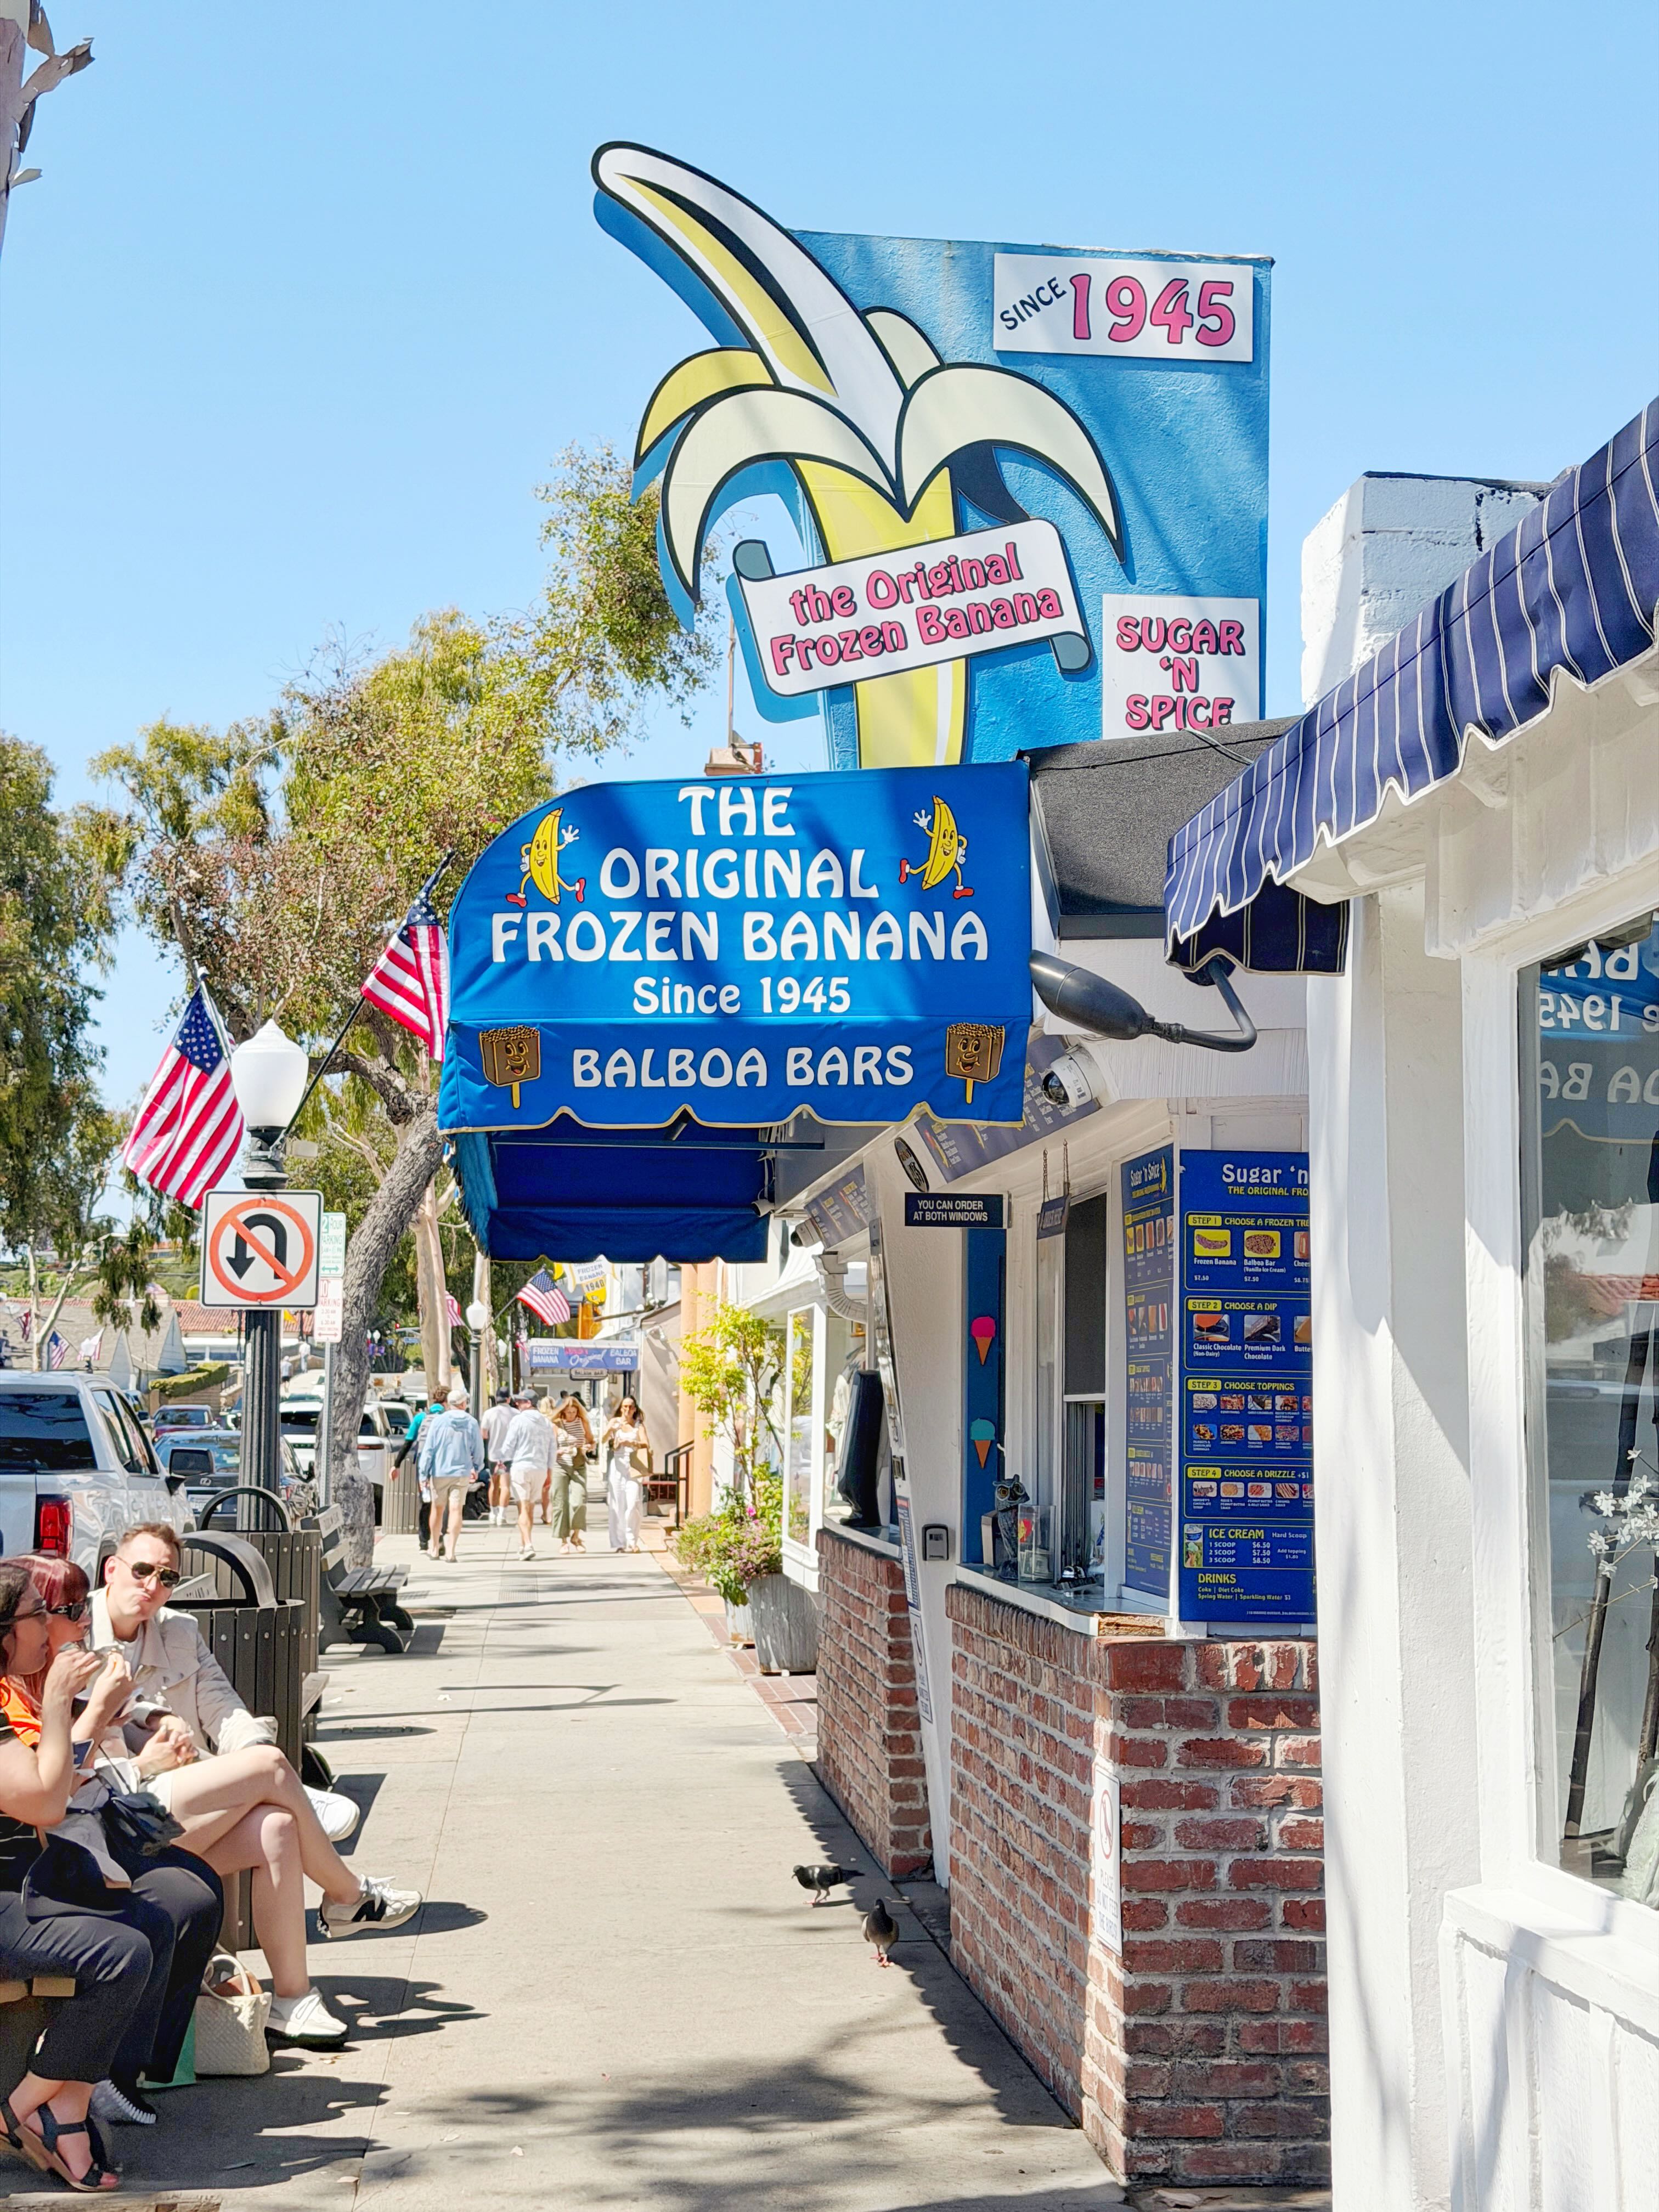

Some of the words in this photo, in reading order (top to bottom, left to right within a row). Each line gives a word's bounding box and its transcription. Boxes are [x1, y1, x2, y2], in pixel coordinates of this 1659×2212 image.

[1000, 276, 1067, 330] SINCE
[1070, 273, 1235, 346] 1945
[789, 584, 856, 626] the
[866, 542, 1024, 610] Original
[770, 620, 907, 675] Frozen
[915, 588, 1064, 646] Banana
[1116, 615, 1245, 656] SUGAR
[1159, 656, 1200, 693] 'N
[1125, 693, 1235, 731] SPICE
[678, 786, 795, 836] THE
[599, 848, 879, 899] ORIGINAL
[492, 911, 719, 962] FROZEN
[743, 910, 988, 961] BANANA
[633, 977, 741, 1014] Since
[760, 977, 850, 1014] 1945
[573, 1047, 768, 1088] BALBOA
[786, 1046, 913, 1086] BARS
[1222, 1164, 1282, 1184] Sugar
[1228, 1186, 1245, 1195] THE
[1247, 1186, 1289, 1196] ORIGINAL
[918, 1200, 934, 1210] YOU
[936, 1200, 952, 1210] CAN
[955, 1200, 984, 1210] ORDER
[913, 1211, 923, 1221] AT
[926, 1211, 947, 1221] BOTH
[949, 1212, 988, 1222] WINDOWS
[578, 1263, 603, 1274] FROZEN
[579, 1270, 605, 1282] BANANA
[1224, 1302, 1255, 1310] CHOOSE
[533, 1347, 558, 1355] FROZEN
[610, 1349, 637, 1357] BALBOA
[533, 1355, 558, 1364] BANANA
[616, 1357, 631, 1365] BAR
[1224, 1381, 1255, 1390] CHOOSE
[1257, 1383, 1295, 1391] TOPPINGS
[1224, 1469, 1255, 1477] CHOOSE
[1265, 1470, 1296, 1479] DRIZZLE
[1209, 1528, 1226, 1538] ICE
[1228, 1528, 1264, 1539] CREAM
[1198, 1573, 1237, 1584] DRINKS
[1100, 1869, 1114, 1894] PLEASE
